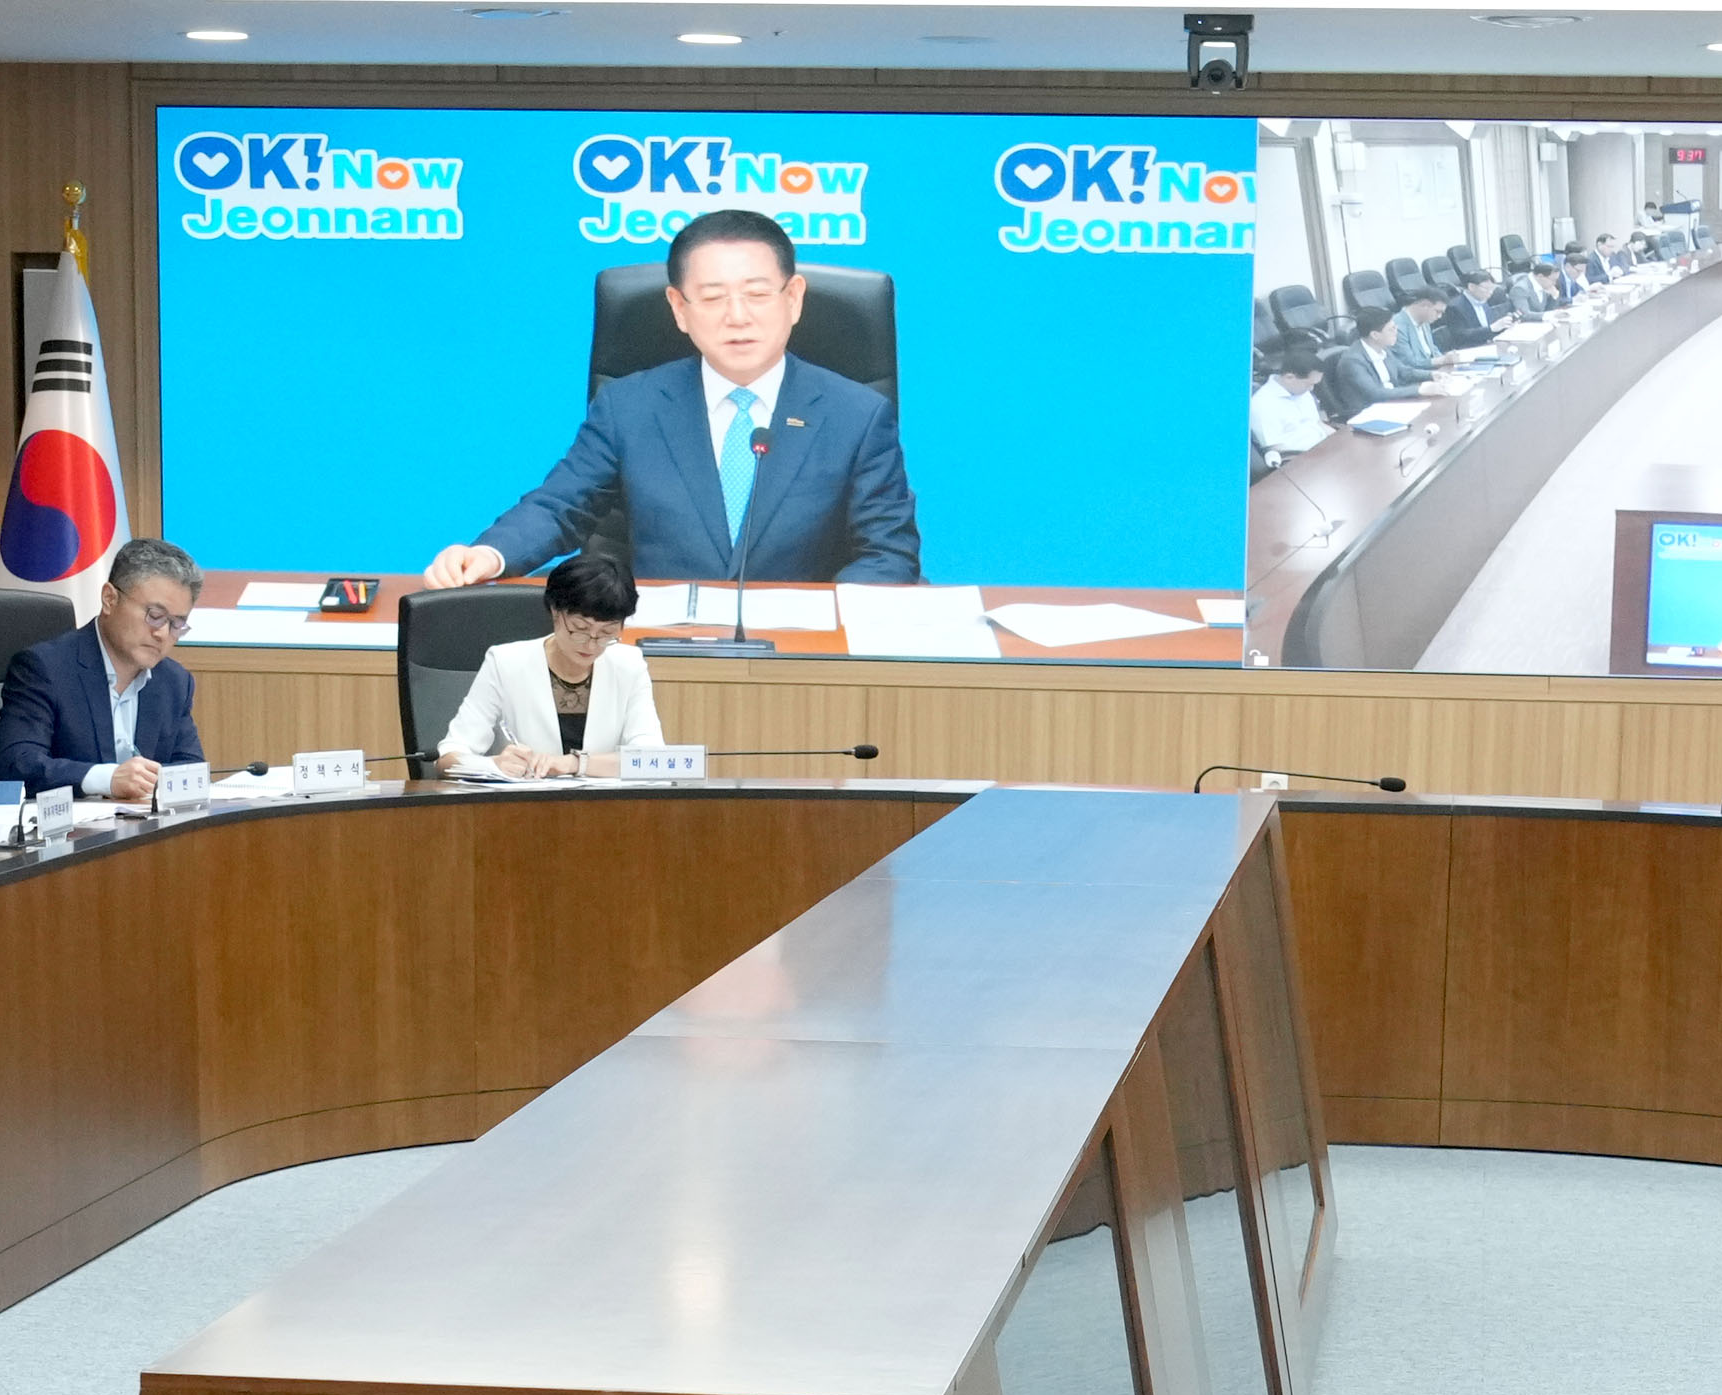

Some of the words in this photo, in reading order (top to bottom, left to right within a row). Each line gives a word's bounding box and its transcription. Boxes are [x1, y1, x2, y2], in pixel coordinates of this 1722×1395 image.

[180, 136, 323, 191] OK!
[579, 139, 726, 195] OK!
[1000, 148, 1151, 204] OK!
[186, 199, 458, 234] Jeonnam
[587, 202, 861, 240] Jeoam
[299, 761, 360, 779] 정책수석
[631, 757, 694, 769] 비서실장
